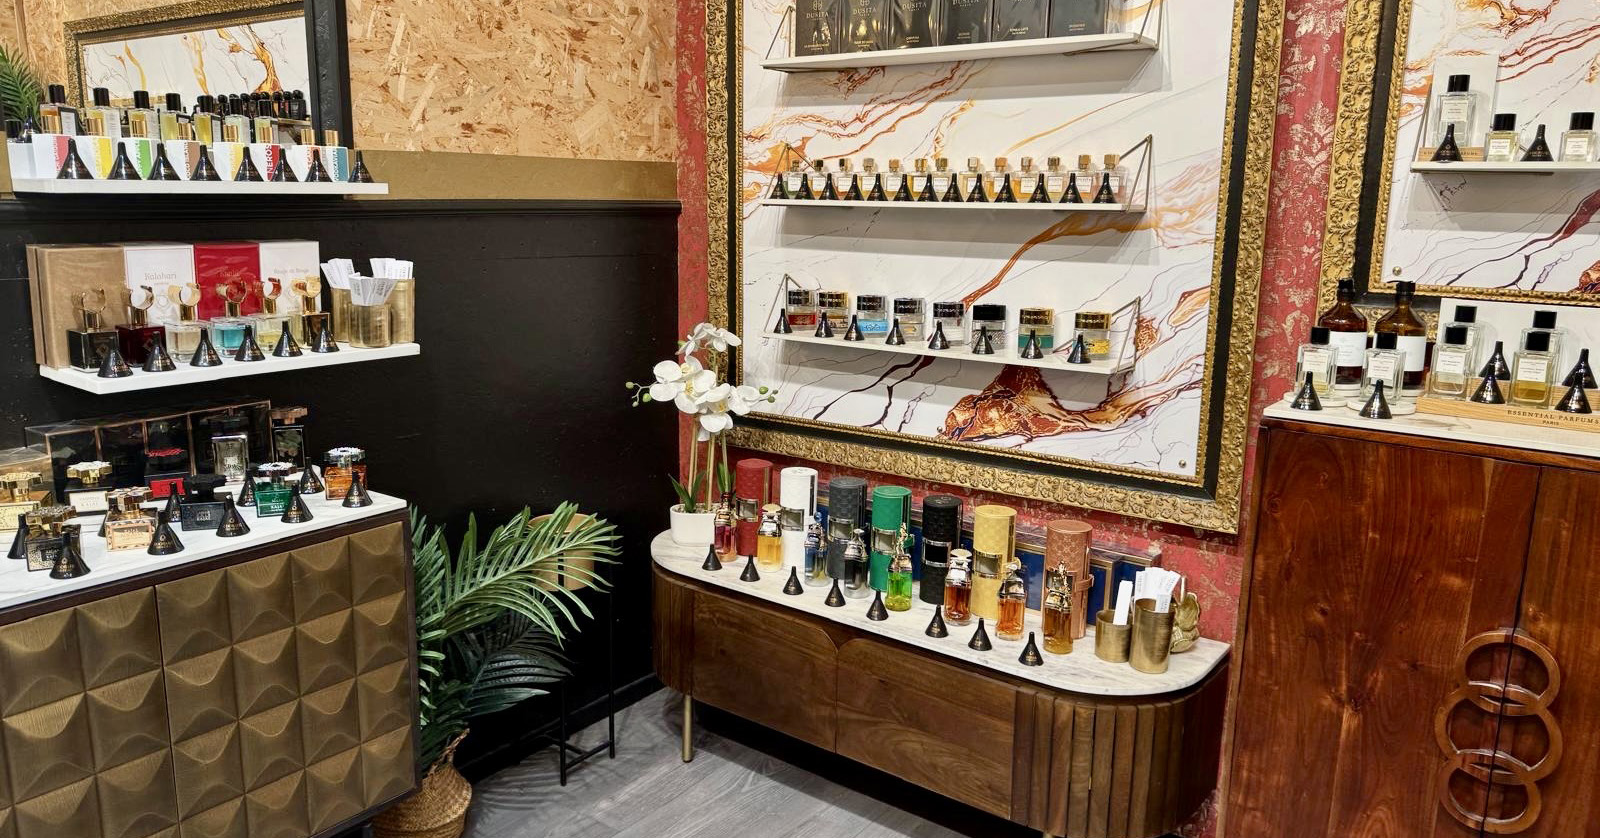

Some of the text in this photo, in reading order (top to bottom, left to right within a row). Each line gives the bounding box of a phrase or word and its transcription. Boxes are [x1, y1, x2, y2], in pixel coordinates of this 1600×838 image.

[902, 2, 927, 10] DUSITA
[806, 11, 829, 19] DUSITA
[853, 7, 877, 15] DUSITA
[144, 271, 177, 281] Kalahari
[1507, 410, 1600, 425] ESSENTIAL PARFUMS
